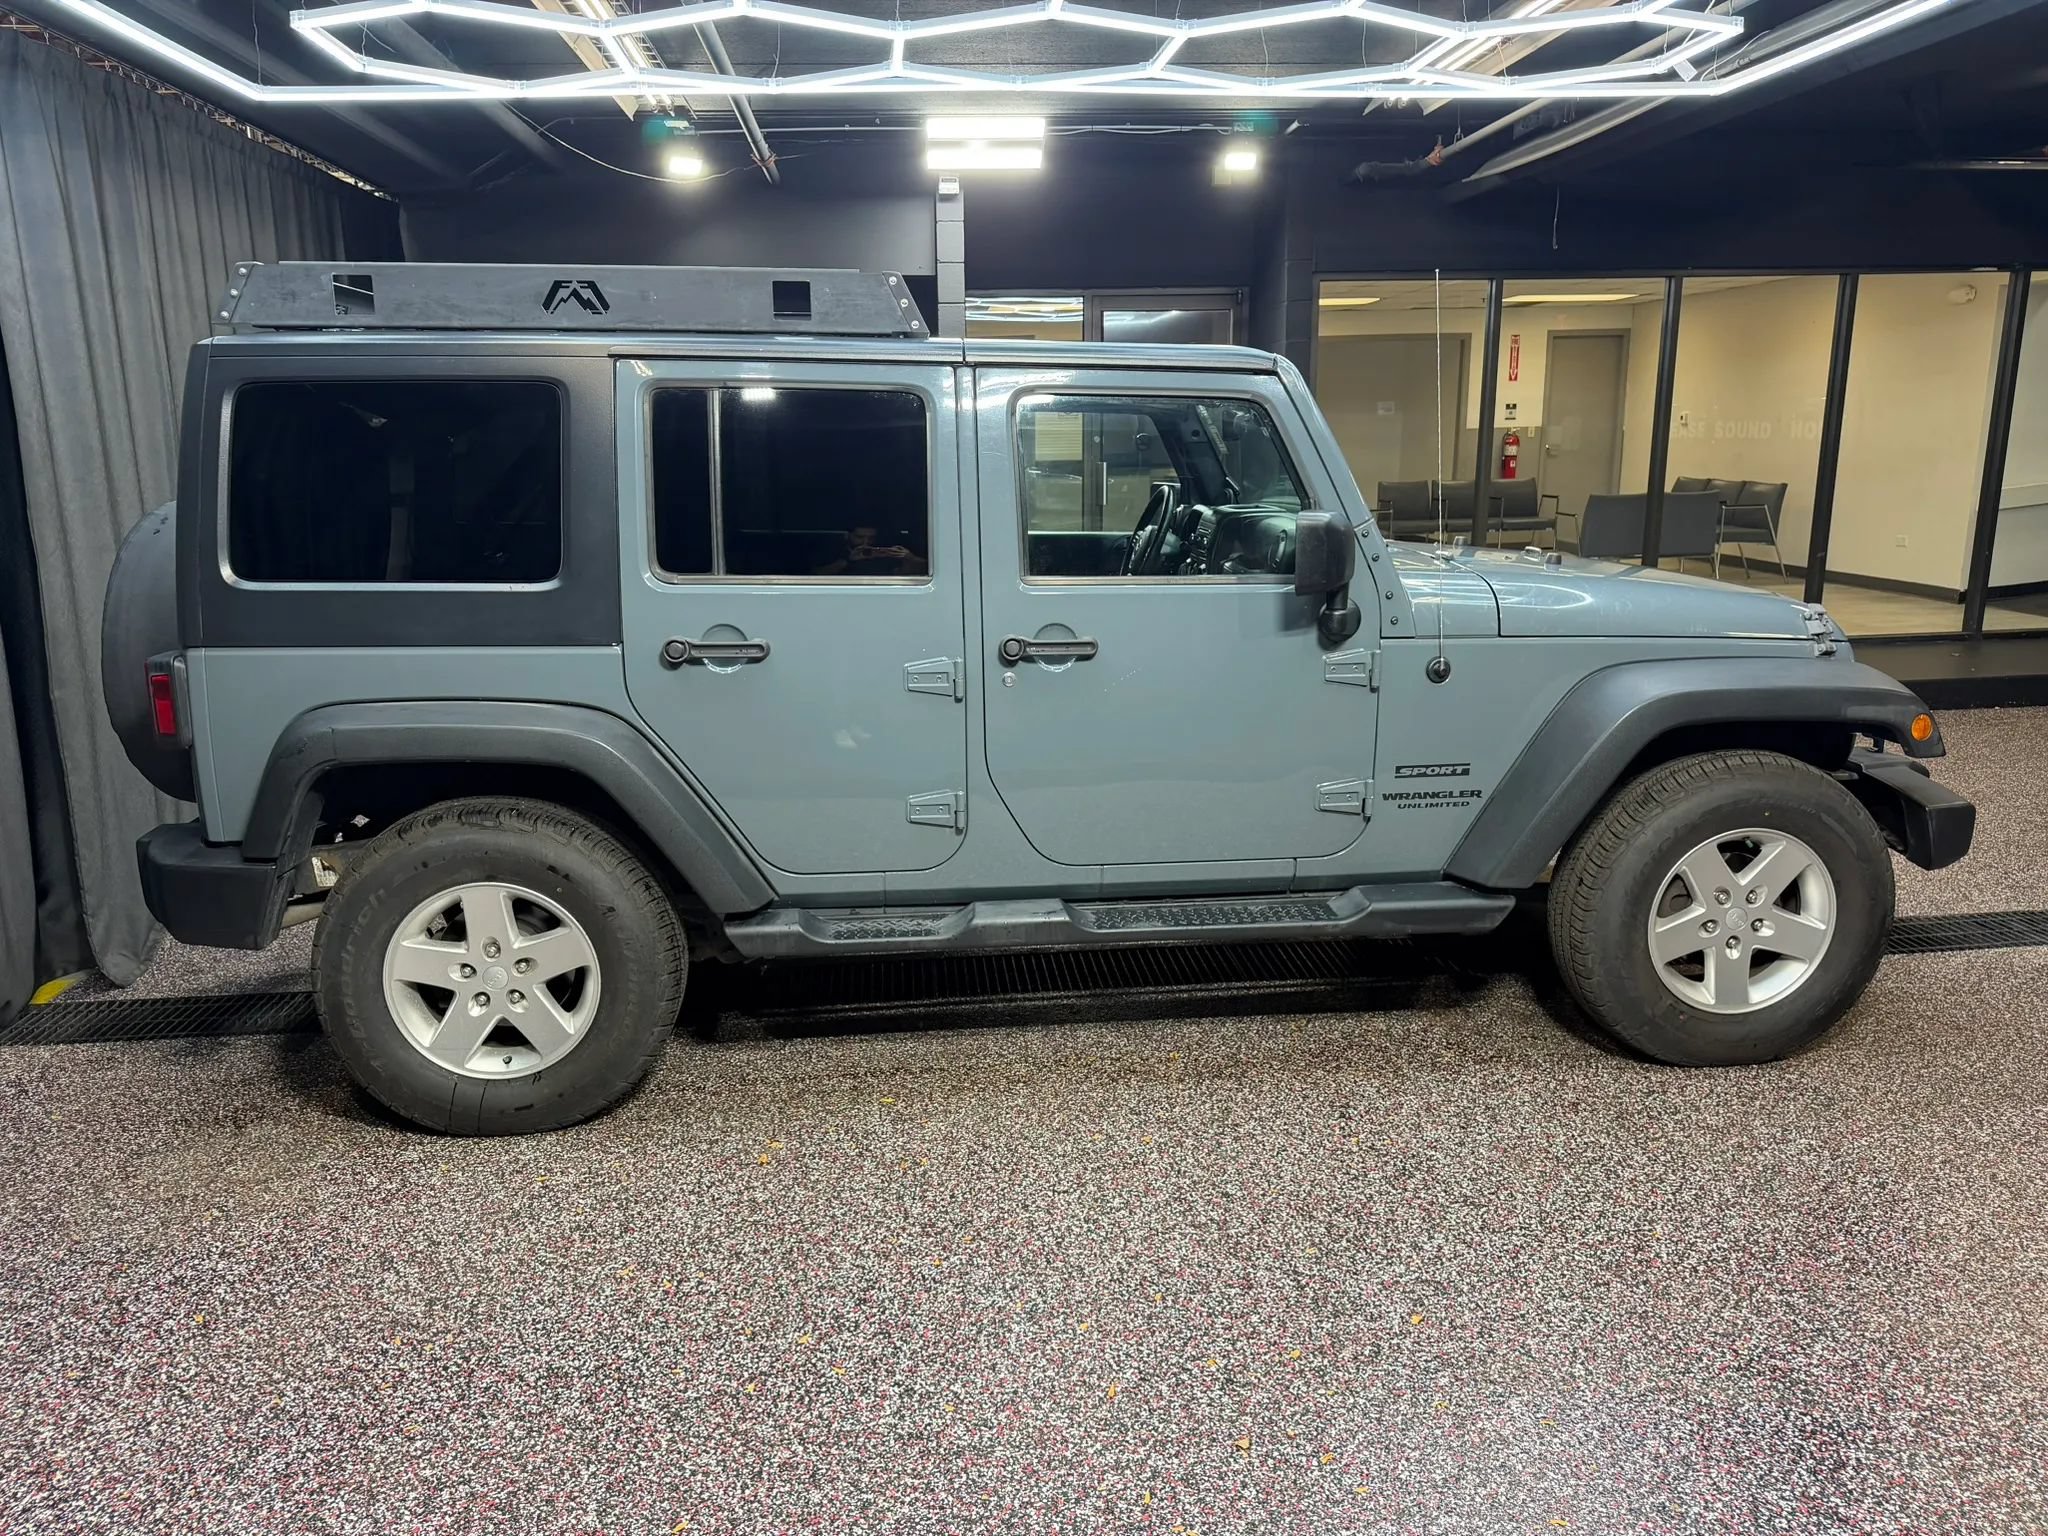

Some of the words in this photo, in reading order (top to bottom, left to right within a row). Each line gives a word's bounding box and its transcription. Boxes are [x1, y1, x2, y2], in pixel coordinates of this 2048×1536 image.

[1713, 420, 1772, 439] SOUND
[1398, 764, 1470, 777] SPORT
[1382, 789, 1483, 801] WRANGLER
[1397, 801, 1470, 809] UNLIMITED
